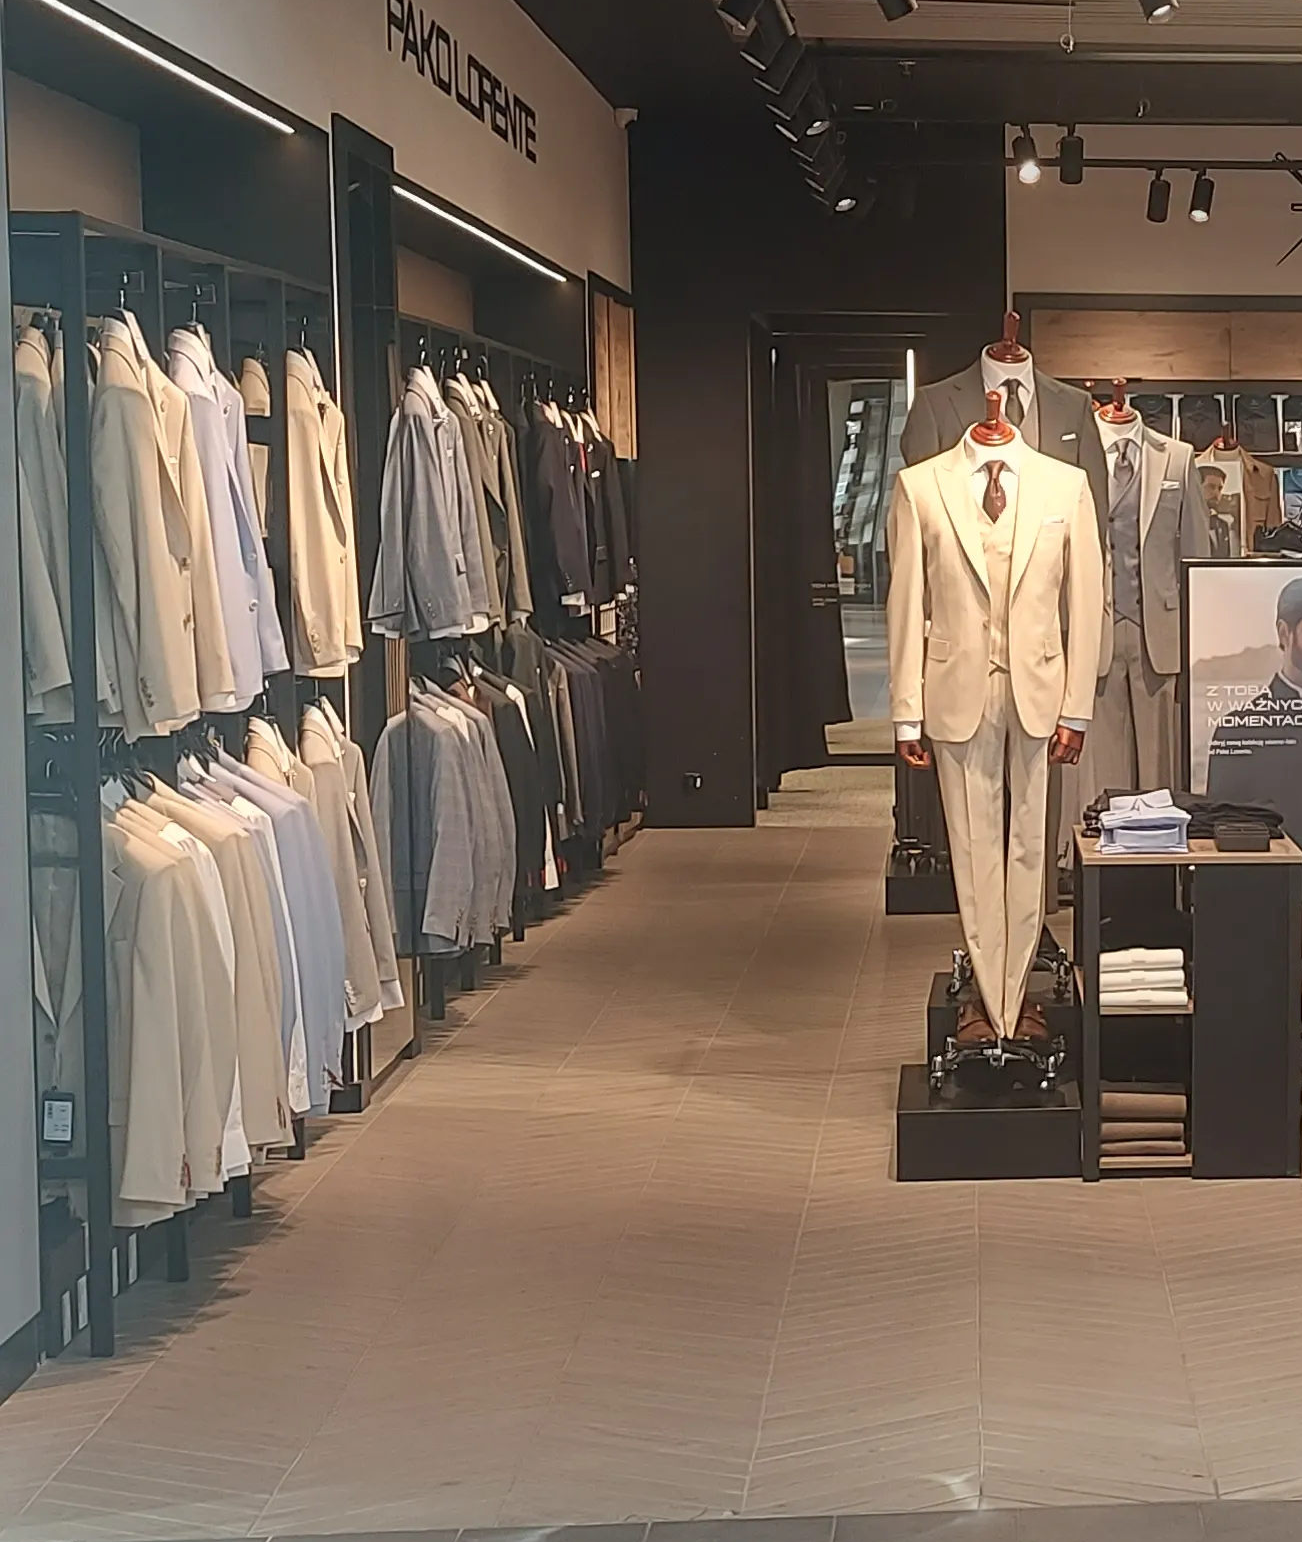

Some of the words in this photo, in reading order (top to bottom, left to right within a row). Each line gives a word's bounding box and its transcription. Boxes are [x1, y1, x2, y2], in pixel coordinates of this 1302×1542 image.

[453, 38, 537, 164] LORENTE
[1206, 685, 1219, 696] Z
[1207, 700, 1223, 712] W
